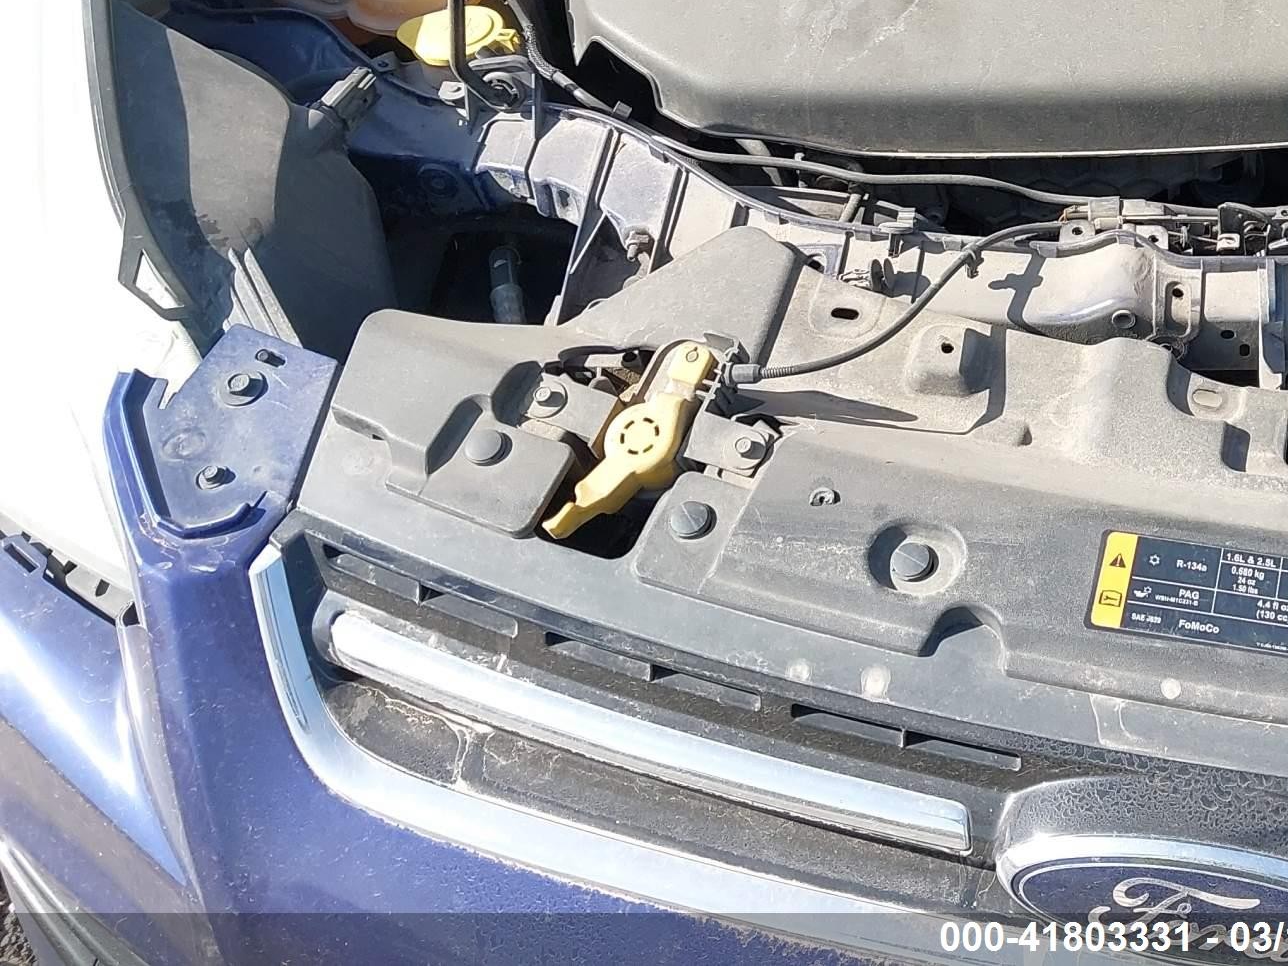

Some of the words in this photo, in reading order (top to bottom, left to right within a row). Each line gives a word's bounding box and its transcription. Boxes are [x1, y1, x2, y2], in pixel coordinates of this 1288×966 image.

[1247, 555, 1255, 564] &
[1176, 559, 1208, 572] R-134a
[1254, 568, 1265, 580] kg
[1237, 576, 1246, 584] 24
[1179, 588, 1200, 600] PAG
[1257, 599, 1271, 609] 4.4
[1272, 601, 1279, 610] fl
[1131, 612, 1145, 622] SAE
[1256, 609, 1276, 620] (130
[1178, 619, 1220, 634] FoMoCo
